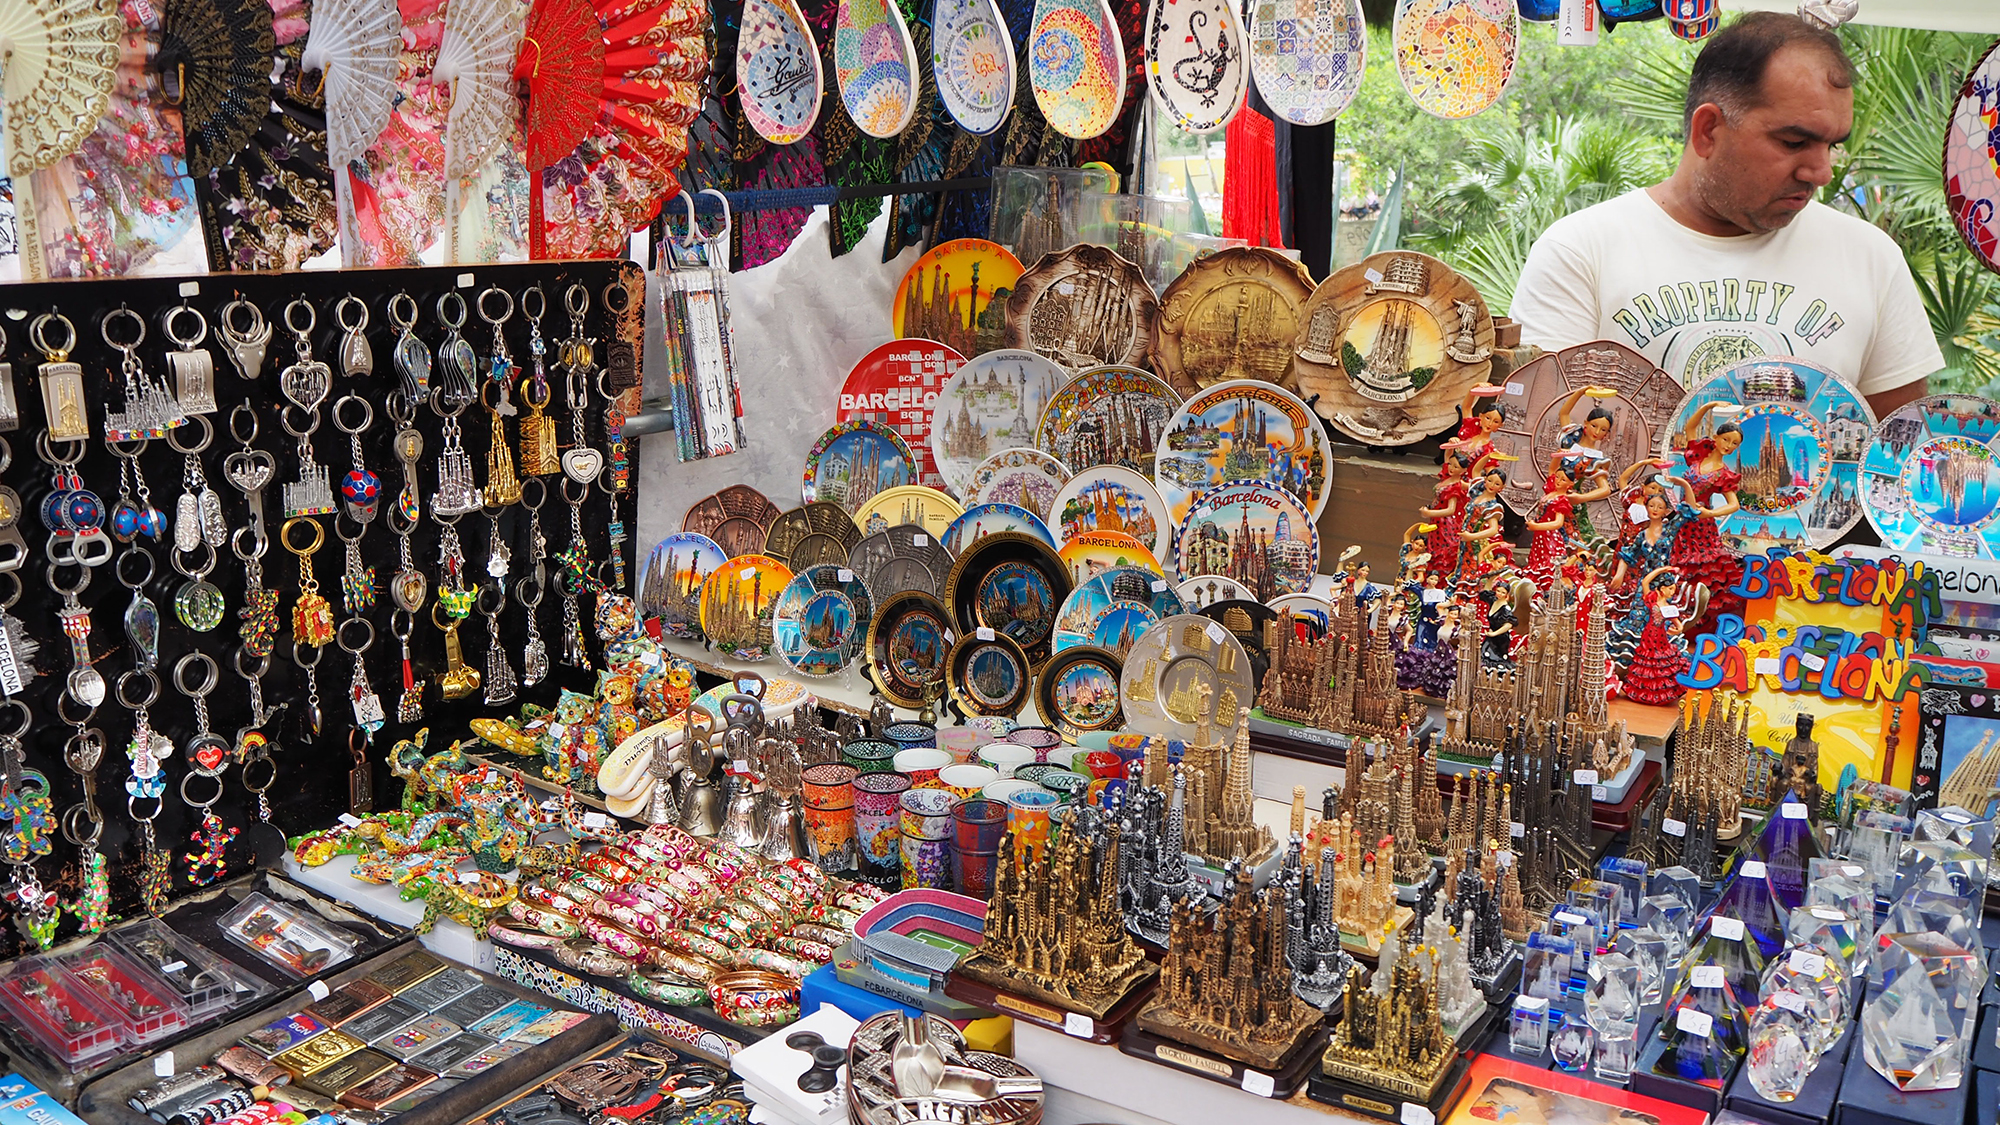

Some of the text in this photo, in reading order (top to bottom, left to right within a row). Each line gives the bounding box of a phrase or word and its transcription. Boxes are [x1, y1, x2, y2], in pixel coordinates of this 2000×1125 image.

[935, 242, 1003, 260] BARCELONA
[1612, 278, 1845, 349] PROPERTY OF
[889, 353, 945, 363] BARCELONA
[924, 361, 943, 369] BCN
[49, 364, 81, 372] BARCELONA
[898, 375, 916, 383] BCN
[840, 393, 938, 410] BARCELO
[1197, 388, 1294, 413] Barcelona
[1362, 387, 1403, 401] BARCELONA
[901, 411, 923, 420] BCN
[1923, 438, 1990, 460] Barcelona
[1210, 488, 1282, 512] Barcelona
[291, 506, 337, 516] BARCELONA
[976, 504, 1035, 528] BARCELONA
[671, 534, 715, 553] BARCELONA
[974, 530, 1023, 551] BARCELONA
[1078, 537, 1138, 551] BARCELONA
[728, 557, 780, 573] BARCELONA
[945, 550, 972, 600] BARCELONA
[1730, 554, 1927, 628] BARCELONA
[0, 626, 20, 694] BARCELONA
[1676, 633, 1933, 703] BARCELONA
[881, 664, 922, 698] BARCELO
[1287, 728, 1351, 750] SAGRADA FAMILI
[288, 1021, 312, 1037] BCN
[1159, 1046, 1226, 1073] SAGRADA FAMILIA
[1330, 1063, 1419, 1098] SAGRADA FAMILIA
[1348, 1096, 1387, 1111] BARCELONA
[26, 1107, 63, 1125] GAU
